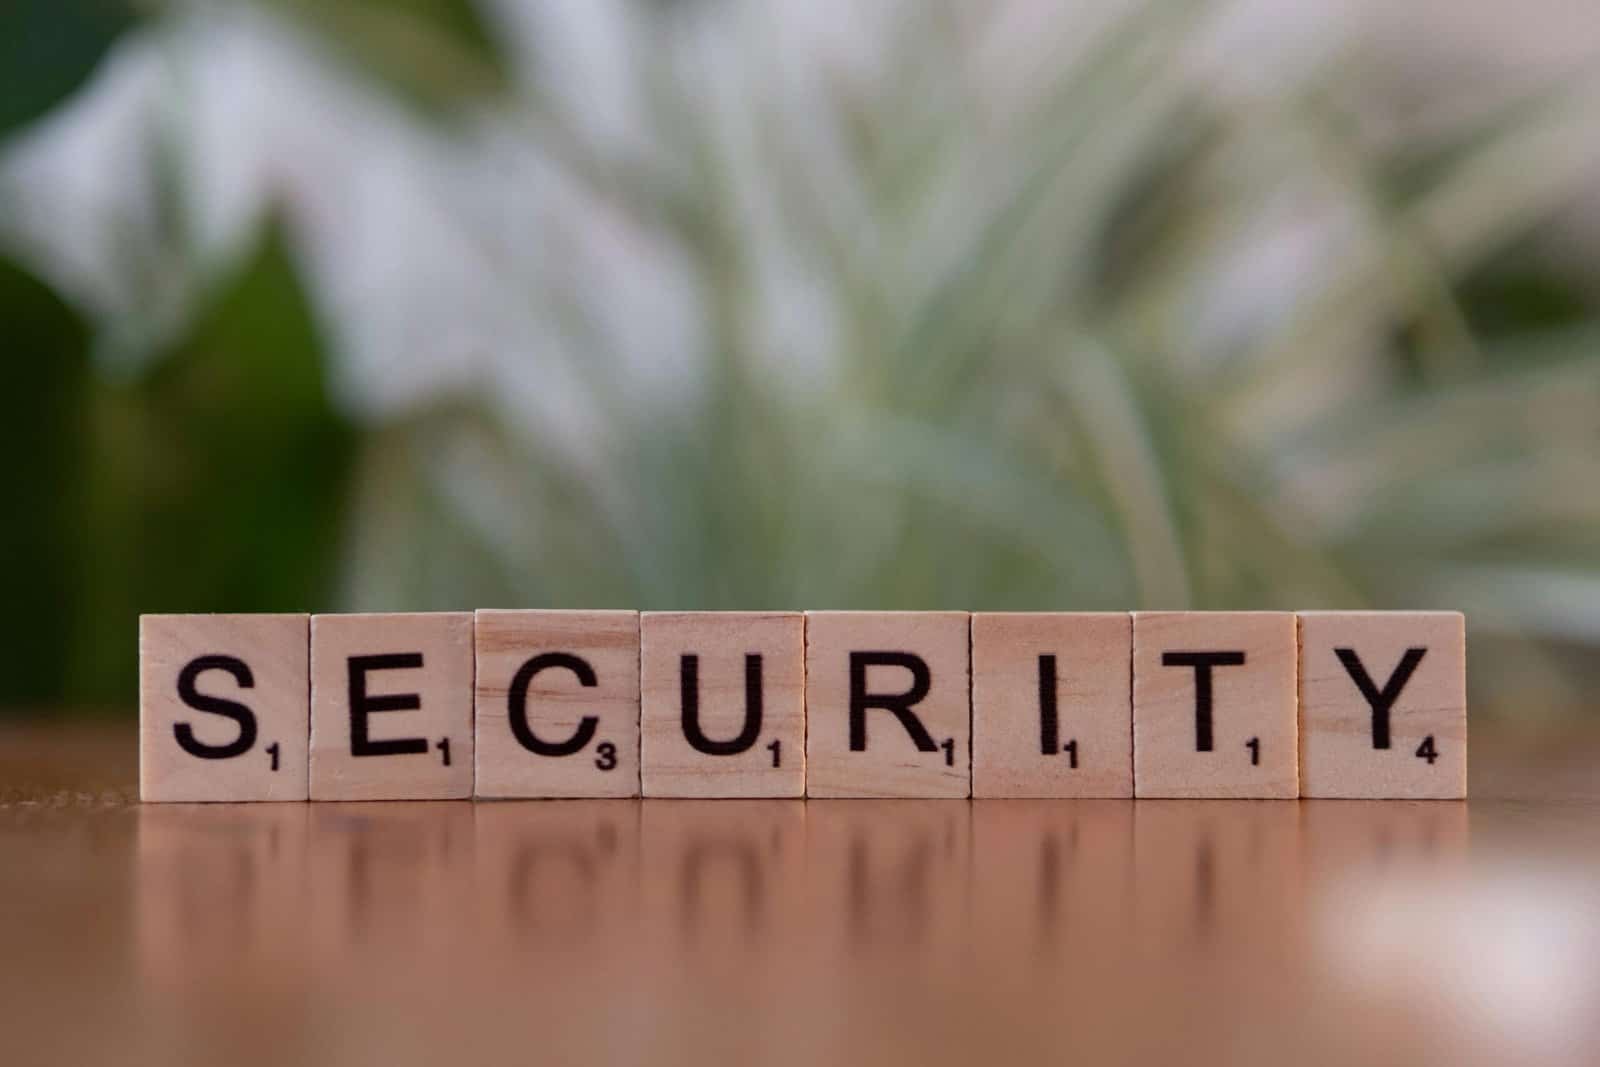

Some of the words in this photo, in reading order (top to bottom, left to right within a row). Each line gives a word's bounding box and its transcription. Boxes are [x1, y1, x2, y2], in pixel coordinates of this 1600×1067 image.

[173, 647, 1428, 760] SECURITY
[265, 742, 280, 772] 1
[435, 737, 452, 767] 1
[594, 741, 618, 772] 3
[766, 739, 781, 769] 1
[940, 737, 955, 767] 1
[1063, 739, 1079, 769] 1
[1245, 737, 1260, 766] 1
[1414, 735, 1439, 765] 4
